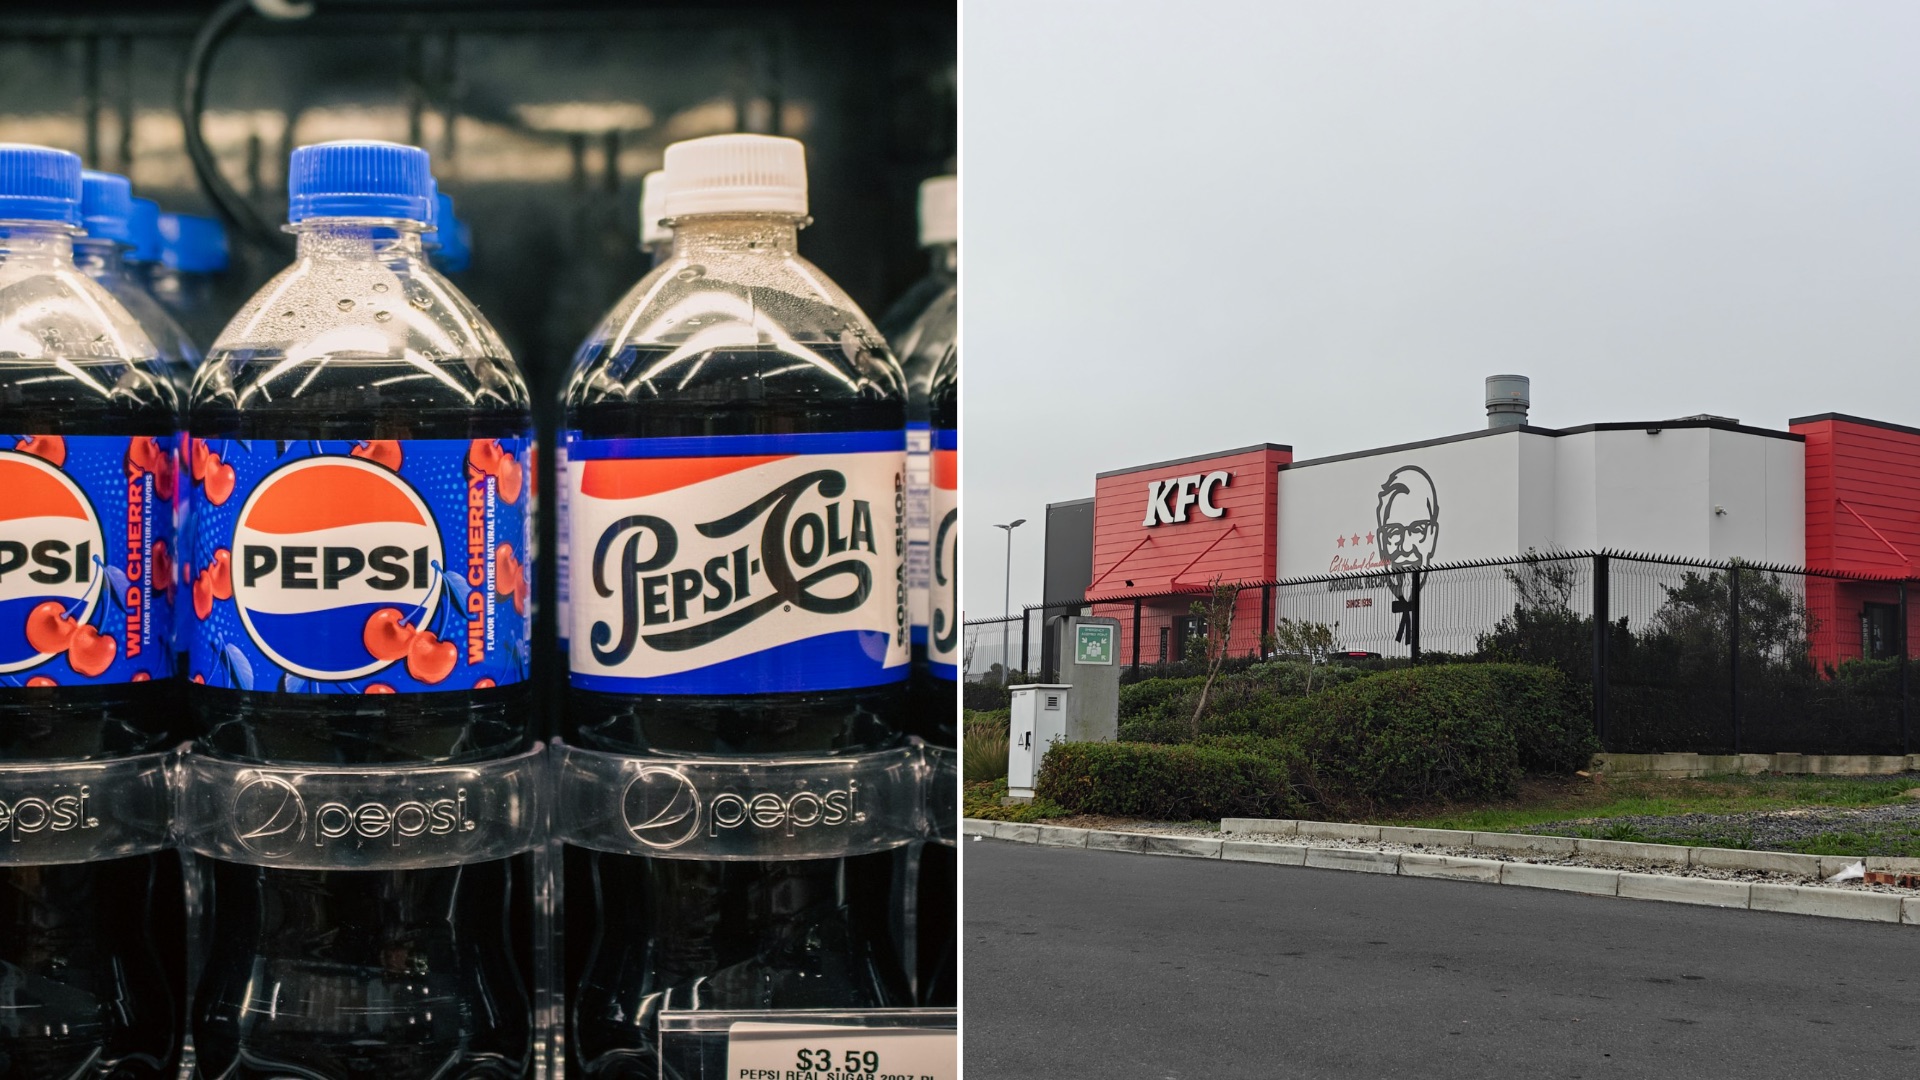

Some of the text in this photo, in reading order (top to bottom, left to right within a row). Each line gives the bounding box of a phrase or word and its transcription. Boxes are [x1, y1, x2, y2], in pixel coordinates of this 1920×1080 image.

[488, 477, 496, 517] FLAVORS
[1142, 471, 1229, 526] KFC
[126, 465, 143, 658] WILD CHERRY
[243, 545, 428, 590] PEPSI
[469, 467, 485, 664] WILD CHERRY
[895, 472, 904, 648] SODA SHOP
[487, 591, 495, 615] WITH
[1346, 599, 1361, 608] SINCE
[487, 617, 495, 650] FLAVOR
[740, 1069, 780, 1080] PEPSI
[786, 1071, 818, 1080] REAL
[796, 1048, 879, 1074] $3.59
